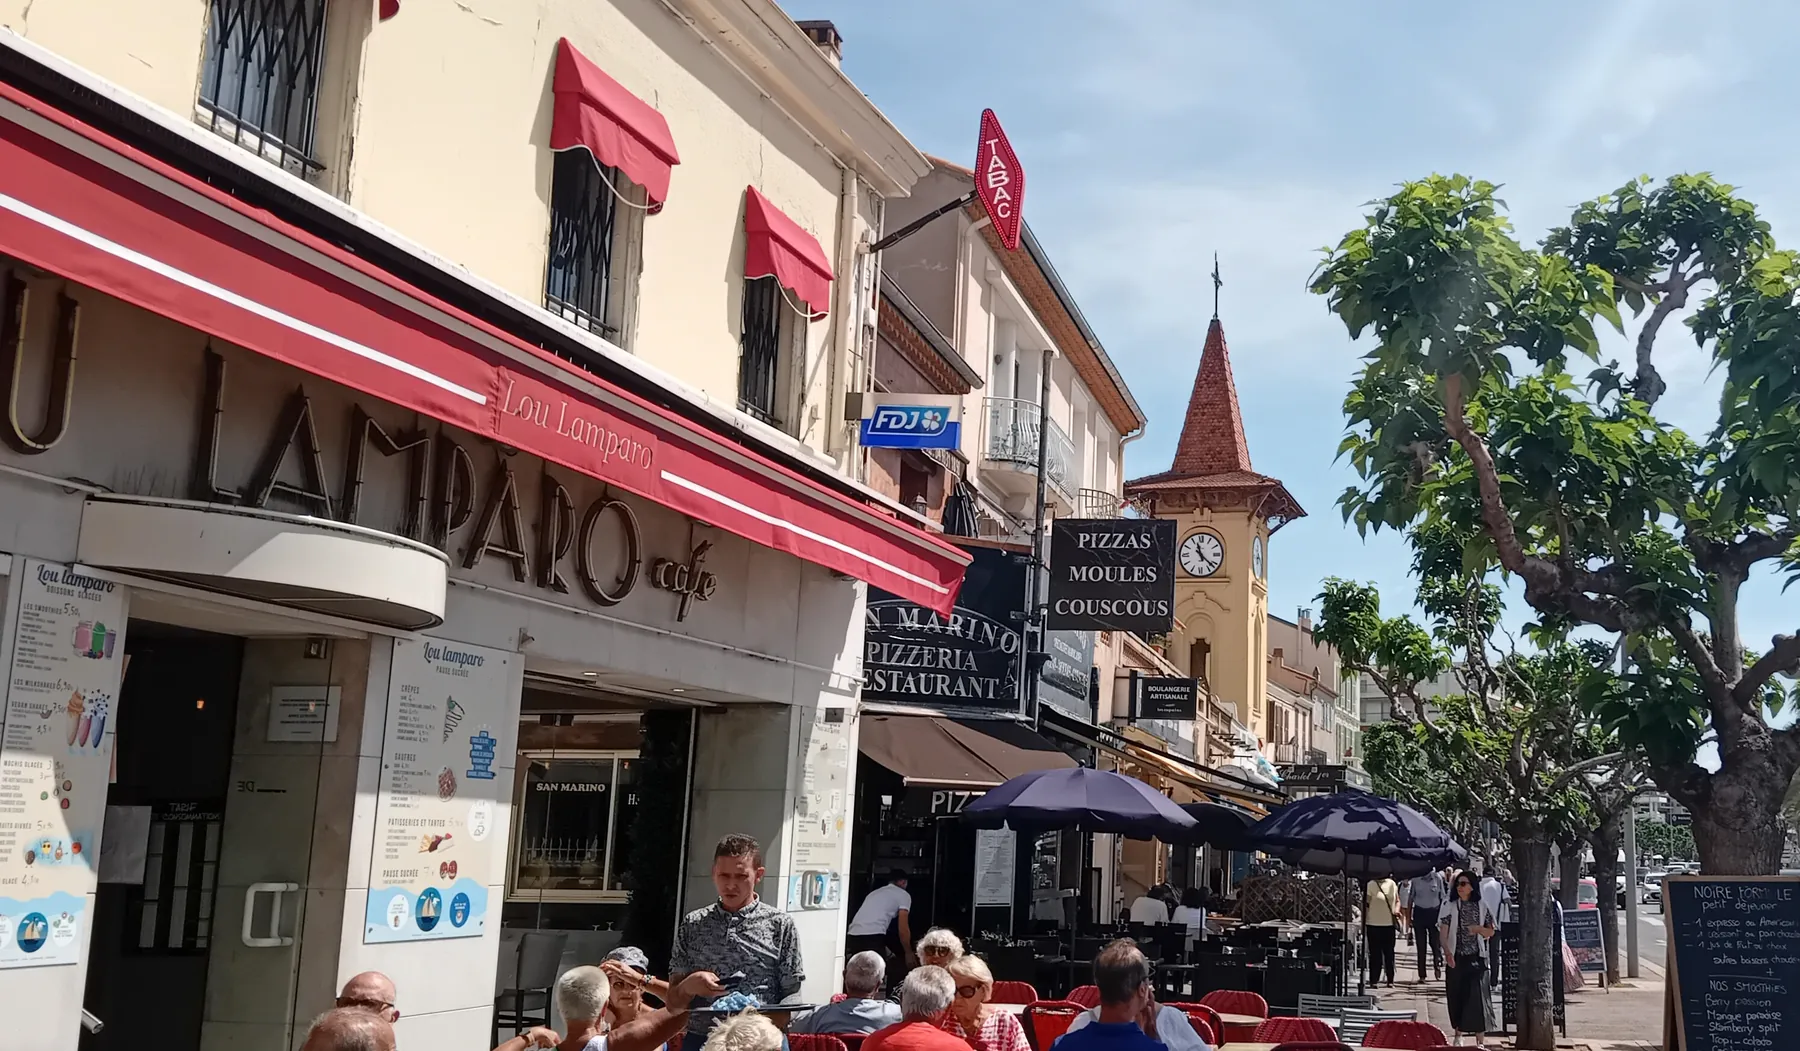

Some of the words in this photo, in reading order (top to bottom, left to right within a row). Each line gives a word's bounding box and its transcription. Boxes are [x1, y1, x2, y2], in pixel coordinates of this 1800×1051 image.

[985, 138, 1011, 219] TABAC
[501, 378, 550, 429] Lou
[556, 399, 654, 470] Lamparo
[875, 410, 920, 430] FDJ
[191, 345, 643, 607] LAMPARO
[1077, 532, 1152, 550] PIZZAS
[36, 563, 60, 586] Lou
[61, 569, 116, 594] lamparo
[1068, 565, 1158, 583] MOULES
[1054, 598, 1169, 617] COUSCOUS
[896, 606, 1019, 655] MARINO
[422, 641, 442, 664] Lou
[442, 646, 486, 669] lamparo
[865, 641, 979, 672] PIZZERIA
[862, 668, 1001, 700] ESTAURANT
[1147, 685, 1191, 693] BOULANGERIE
[1149, 693, 1189, 701] ARTISANALE
[536, 782, 559, 792] SAN
[560, 782, 606, 792] MARINO
[1702, 898, 1728, 914] petit
[1709, 979, 1729, 992] NOS
[1704, 992, 1731, 1012] Berry
[1706, 1009, 1743, 1025] Mangue
[1758, 1021, 1783, 1036] split
